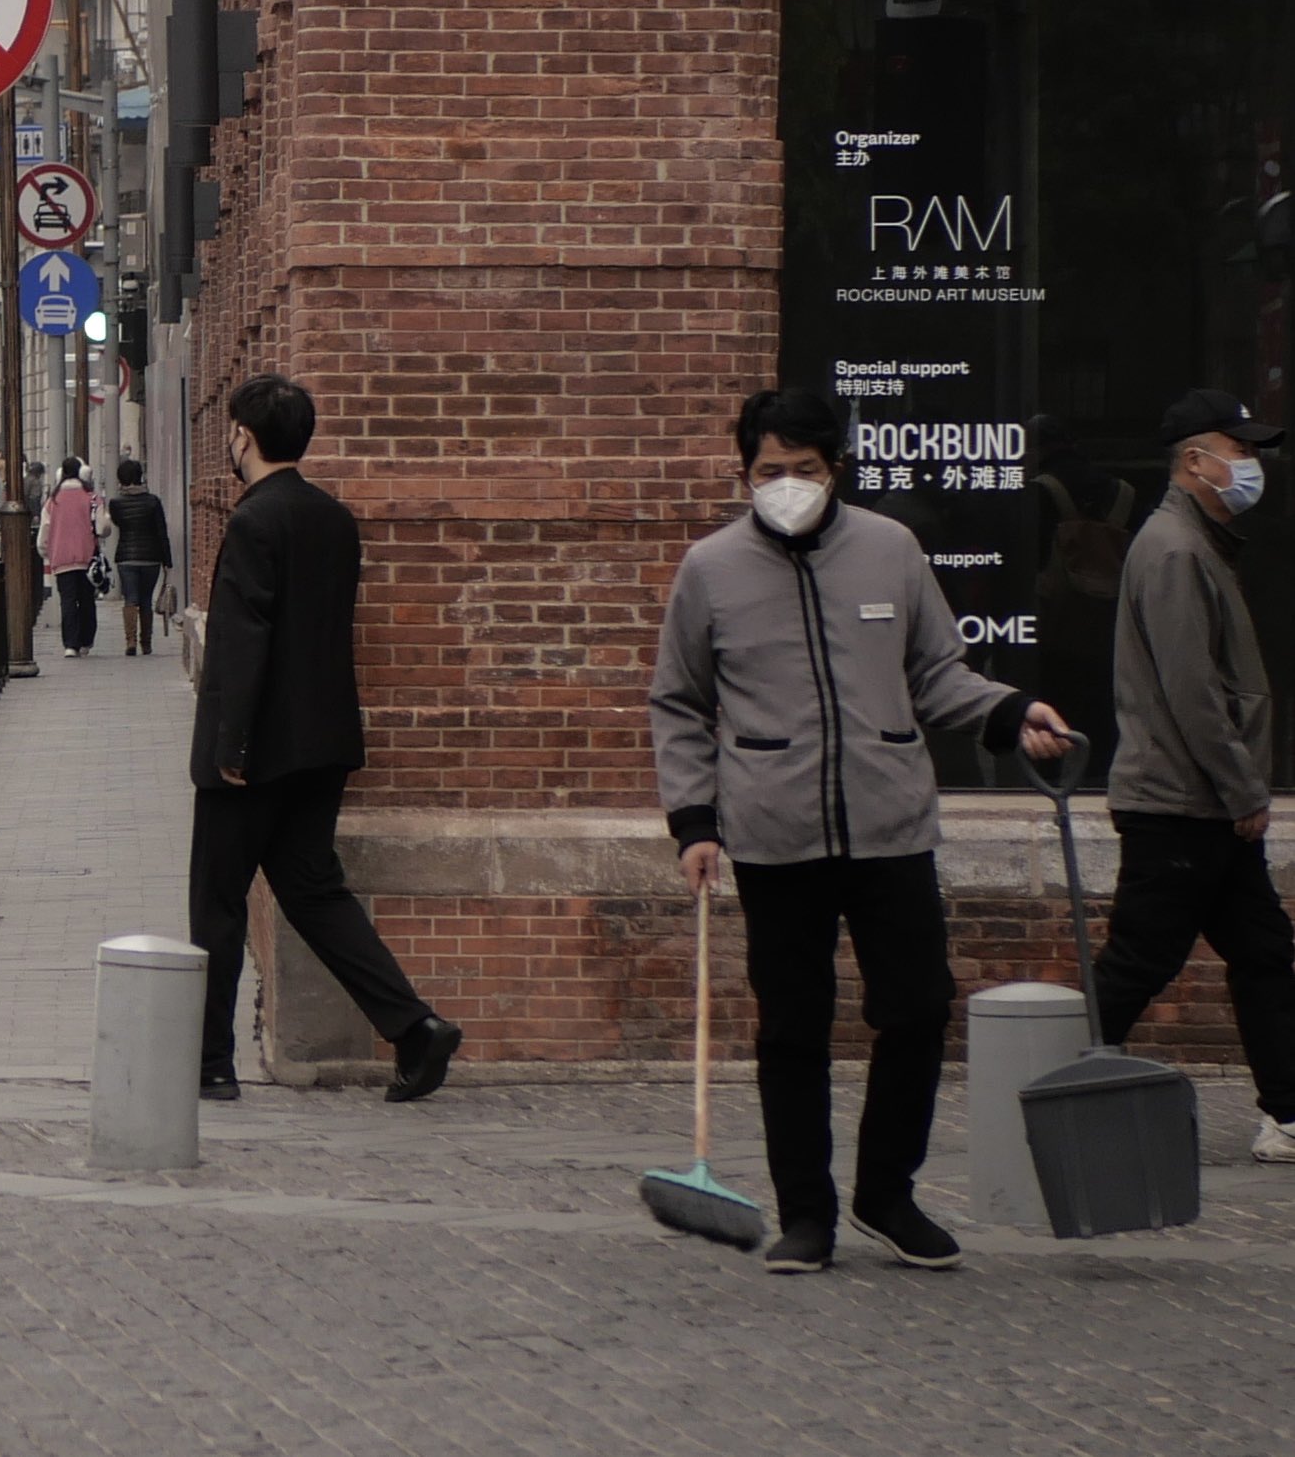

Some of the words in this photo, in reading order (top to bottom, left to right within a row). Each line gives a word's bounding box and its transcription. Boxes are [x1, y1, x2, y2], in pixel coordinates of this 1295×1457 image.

[835, 131, 920, 149] Organizer
[835, 149, 871, 167] 主办
[870, 195, 1012, 252] RAM
[870, 265, 1012, 281] 上海外滩美术馆
[835, 288, 932, 302] ROCKBUND
[935, 288, 967, 302] ART
[971, 288, 1046, 302] MUSEUM
[835, 360, 897, 380] Special
[900, 361, 970, 380] support
[835, 379, 905, 397] 特别支持
[856, 424, 1026, 461] ROCKBUND
[933, 551, 1003, 568] support
[958, 615, 1037, 644] OME
